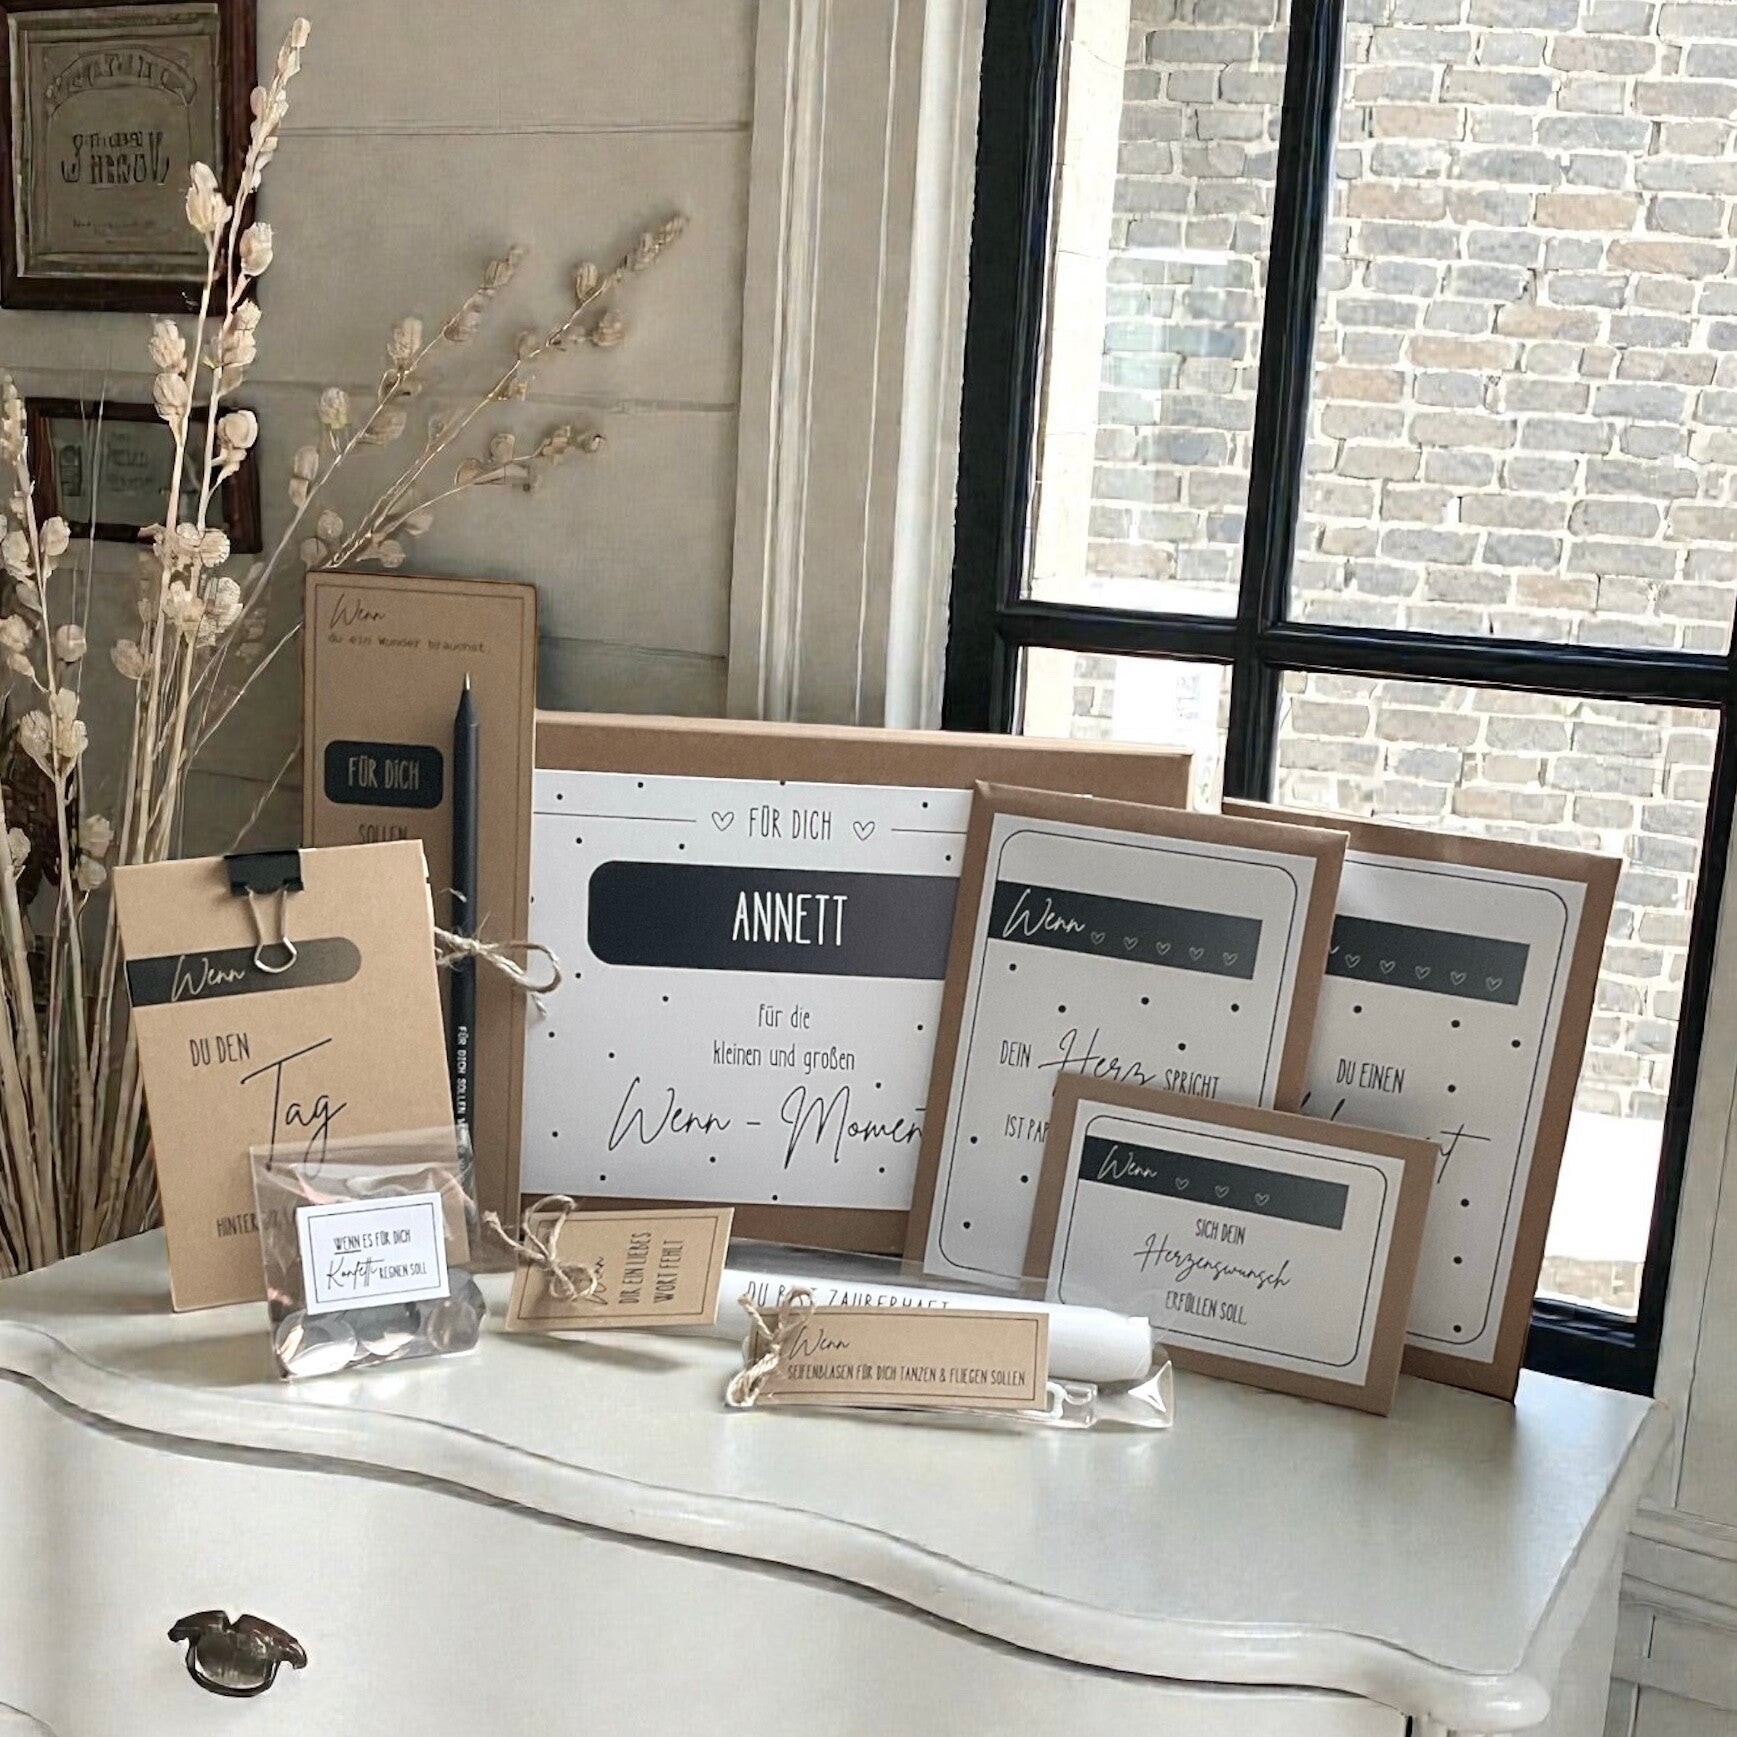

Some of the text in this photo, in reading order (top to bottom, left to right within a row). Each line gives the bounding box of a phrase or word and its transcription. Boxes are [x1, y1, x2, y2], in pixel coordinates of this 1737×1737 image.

[329, 593, 386, 629] Wenn
[348, 754, 379, 788] FÜR
[748, 804, 832, 841] FÜR DICH
[731, 890, 848, 946] ANNETT
[1002, 887, 1086, 938] Wenn
[171, 954, 246, 1002] Wenn
[758, 1003, 810, 1029] für die
[189, 1032, 250, 1067] DU DEN
[457, 1025, 469, 1046] FÜR
[456, 1049, 467, 1074] DICH
[712, 1040, 855, 1076] kleinen und großen
[1000, 1028, 1220, 1099] DEIN Herz SPRICHT
[1336, 1058, 1406, 1094] DU EINEN
[240, 1037, 347, 1178] Tag
[456, 1078, 467, 1114] SOLLEN
[608, 1076, 731, 1152] Wenn
[780, 1085, 927, 1170] Momen
[1004, 1113, 1026, 1140] IST
[1097, 1144, 1159, 1181] Wenn
[333, 1229, 411, 1252] WENN ES FÜR DICH
[1195, 1217, 1247, 1246] SICH DEIN
[326, 1256, 428, 1290] Konfetti REGNEN SOLL
[619, 1231, 652, 1304] DIR EIN LIEBES
[653, 1239, 684, 1304] WORT FEHLT
[1133, 1233, 1292, 1290] Herzenswunsch
[747, 1280, 768, 1308] DU
[1165, 1289, 1217, 1318] ERFÜLLEN
[788, 1326, 850, 1361] Wenn
[787, 1362, 1026, 1387] SEIFENBLASEN FÜR DICH TANZEN & FLIEGEN SOLLEN
